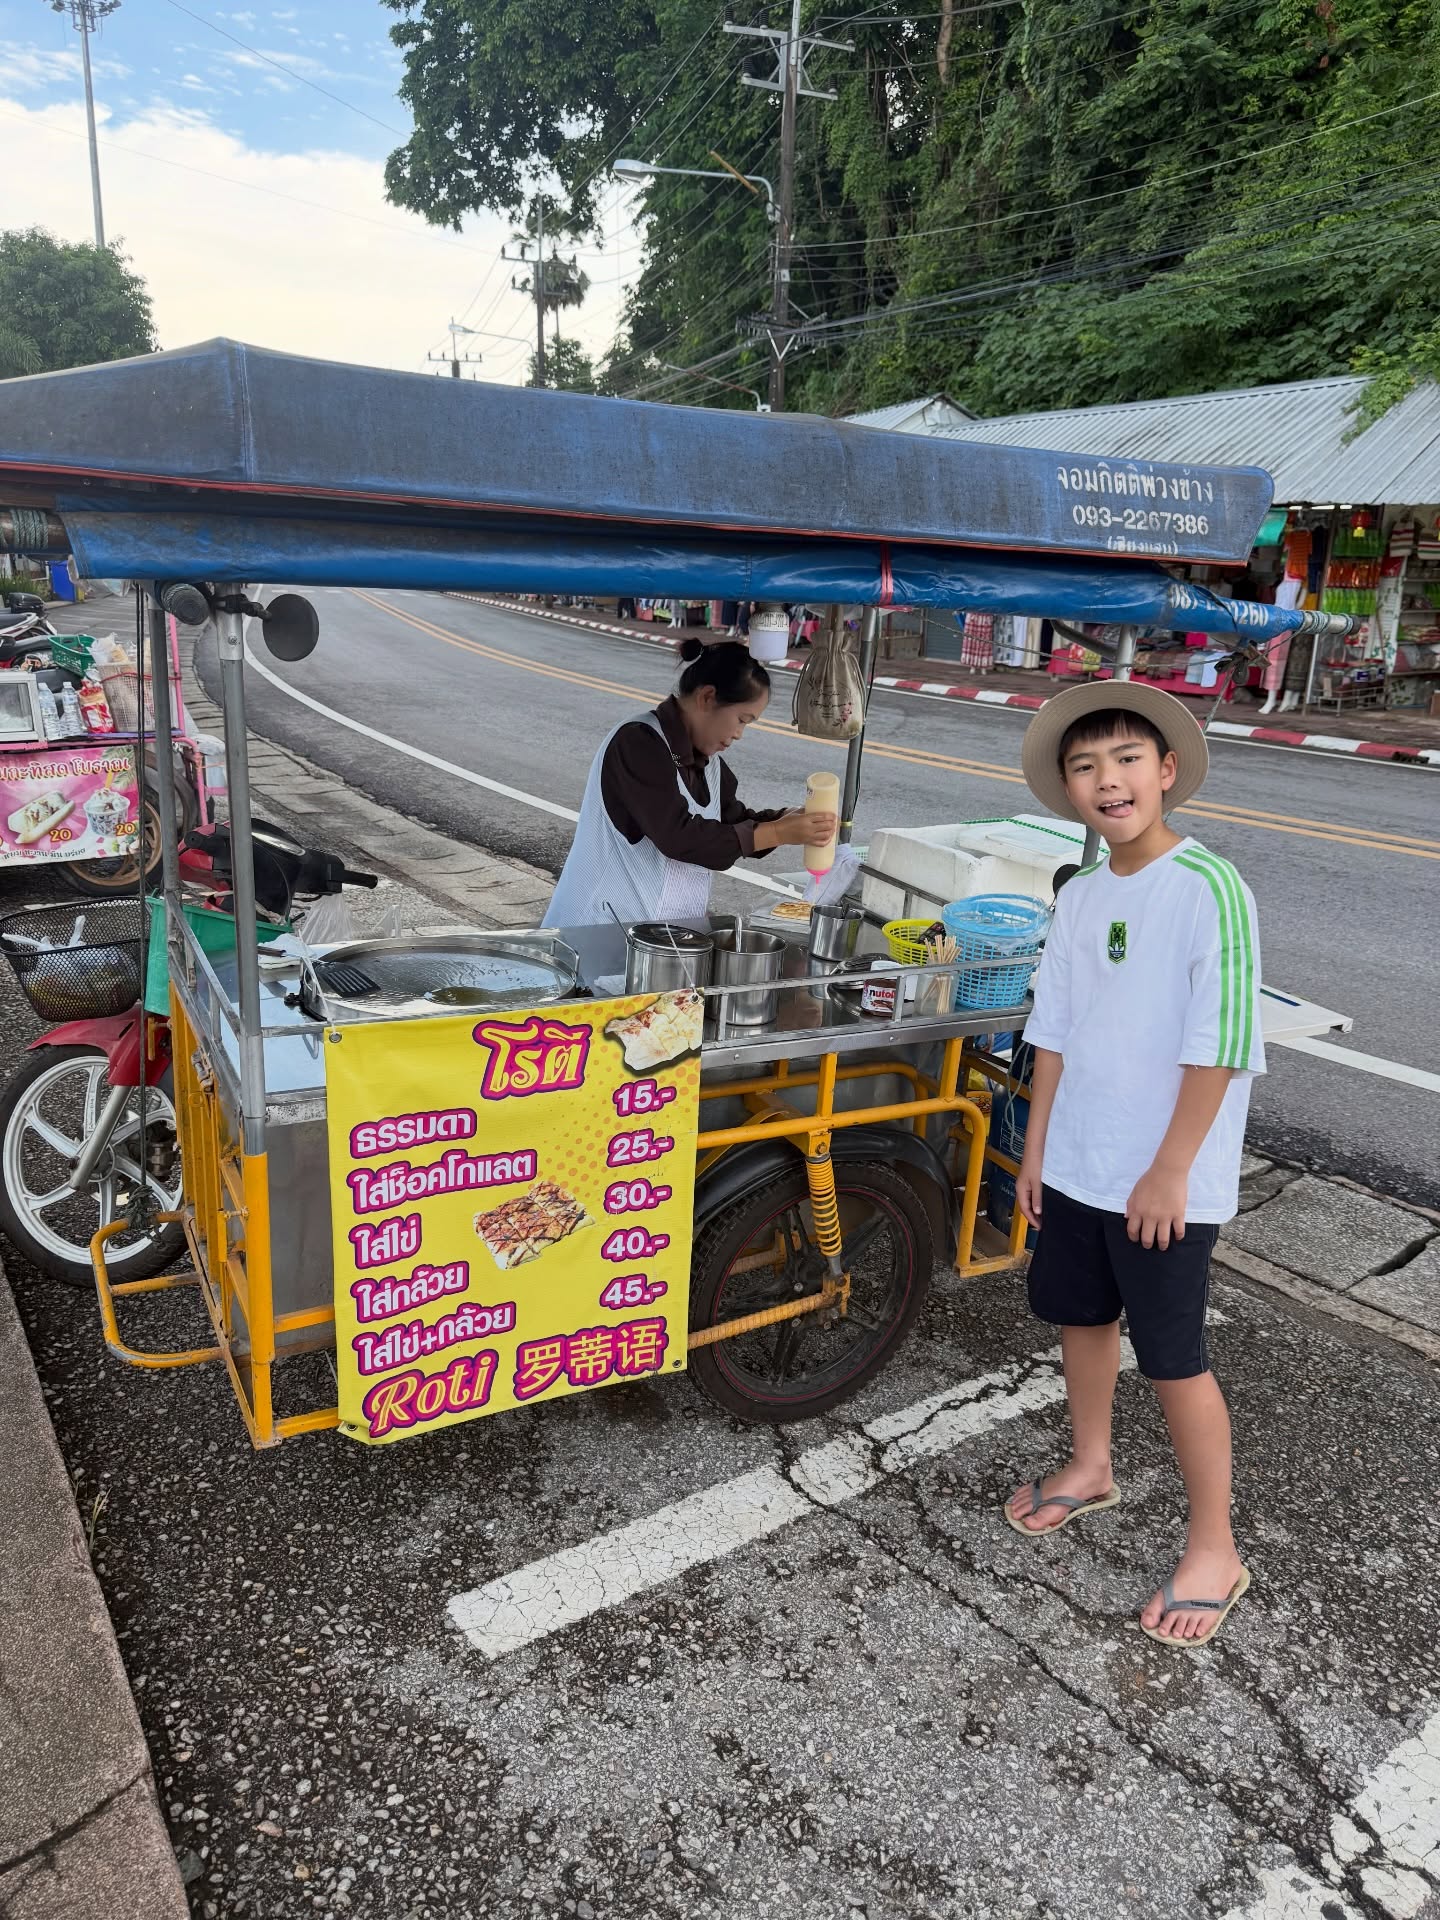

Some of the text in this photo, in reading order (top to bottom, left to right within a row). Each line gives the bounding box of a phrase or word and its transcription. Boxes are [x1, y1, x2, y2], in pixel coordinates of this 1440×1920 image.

[1072, 504, 1209, 536] 093-2267386
[70, 757, 130, 776] โบราณ
[50, 829, 72, 841] 20
[117, 823, 136, 836] 20
[482, 1023, 584, 1093] โรตี
[617, 1085, 672, 1112] 15.-
[356, 1114, 472, 1153] ธรรมดา
[612, 1134, 669, 1162] 25.-
[353, 1155, 532, 1209] ใส่ช็อคโกแลต
[608, 1184, 667, 1210] 30.-
[355, 1220, 417, 1264] ใส่ไข่
[605, 1231, 665, 1257] 40.-
[356, 1266, 464, 1318] ใส่กล้วย
[604, 1280, 663, 1304] 45.-
[357, 1307, 512, 1371] ใส่ไข่+กล้วย
[520, 1323, 662, 1394] 罗蒂语
[371, 1356, 492, 1432] Roti
